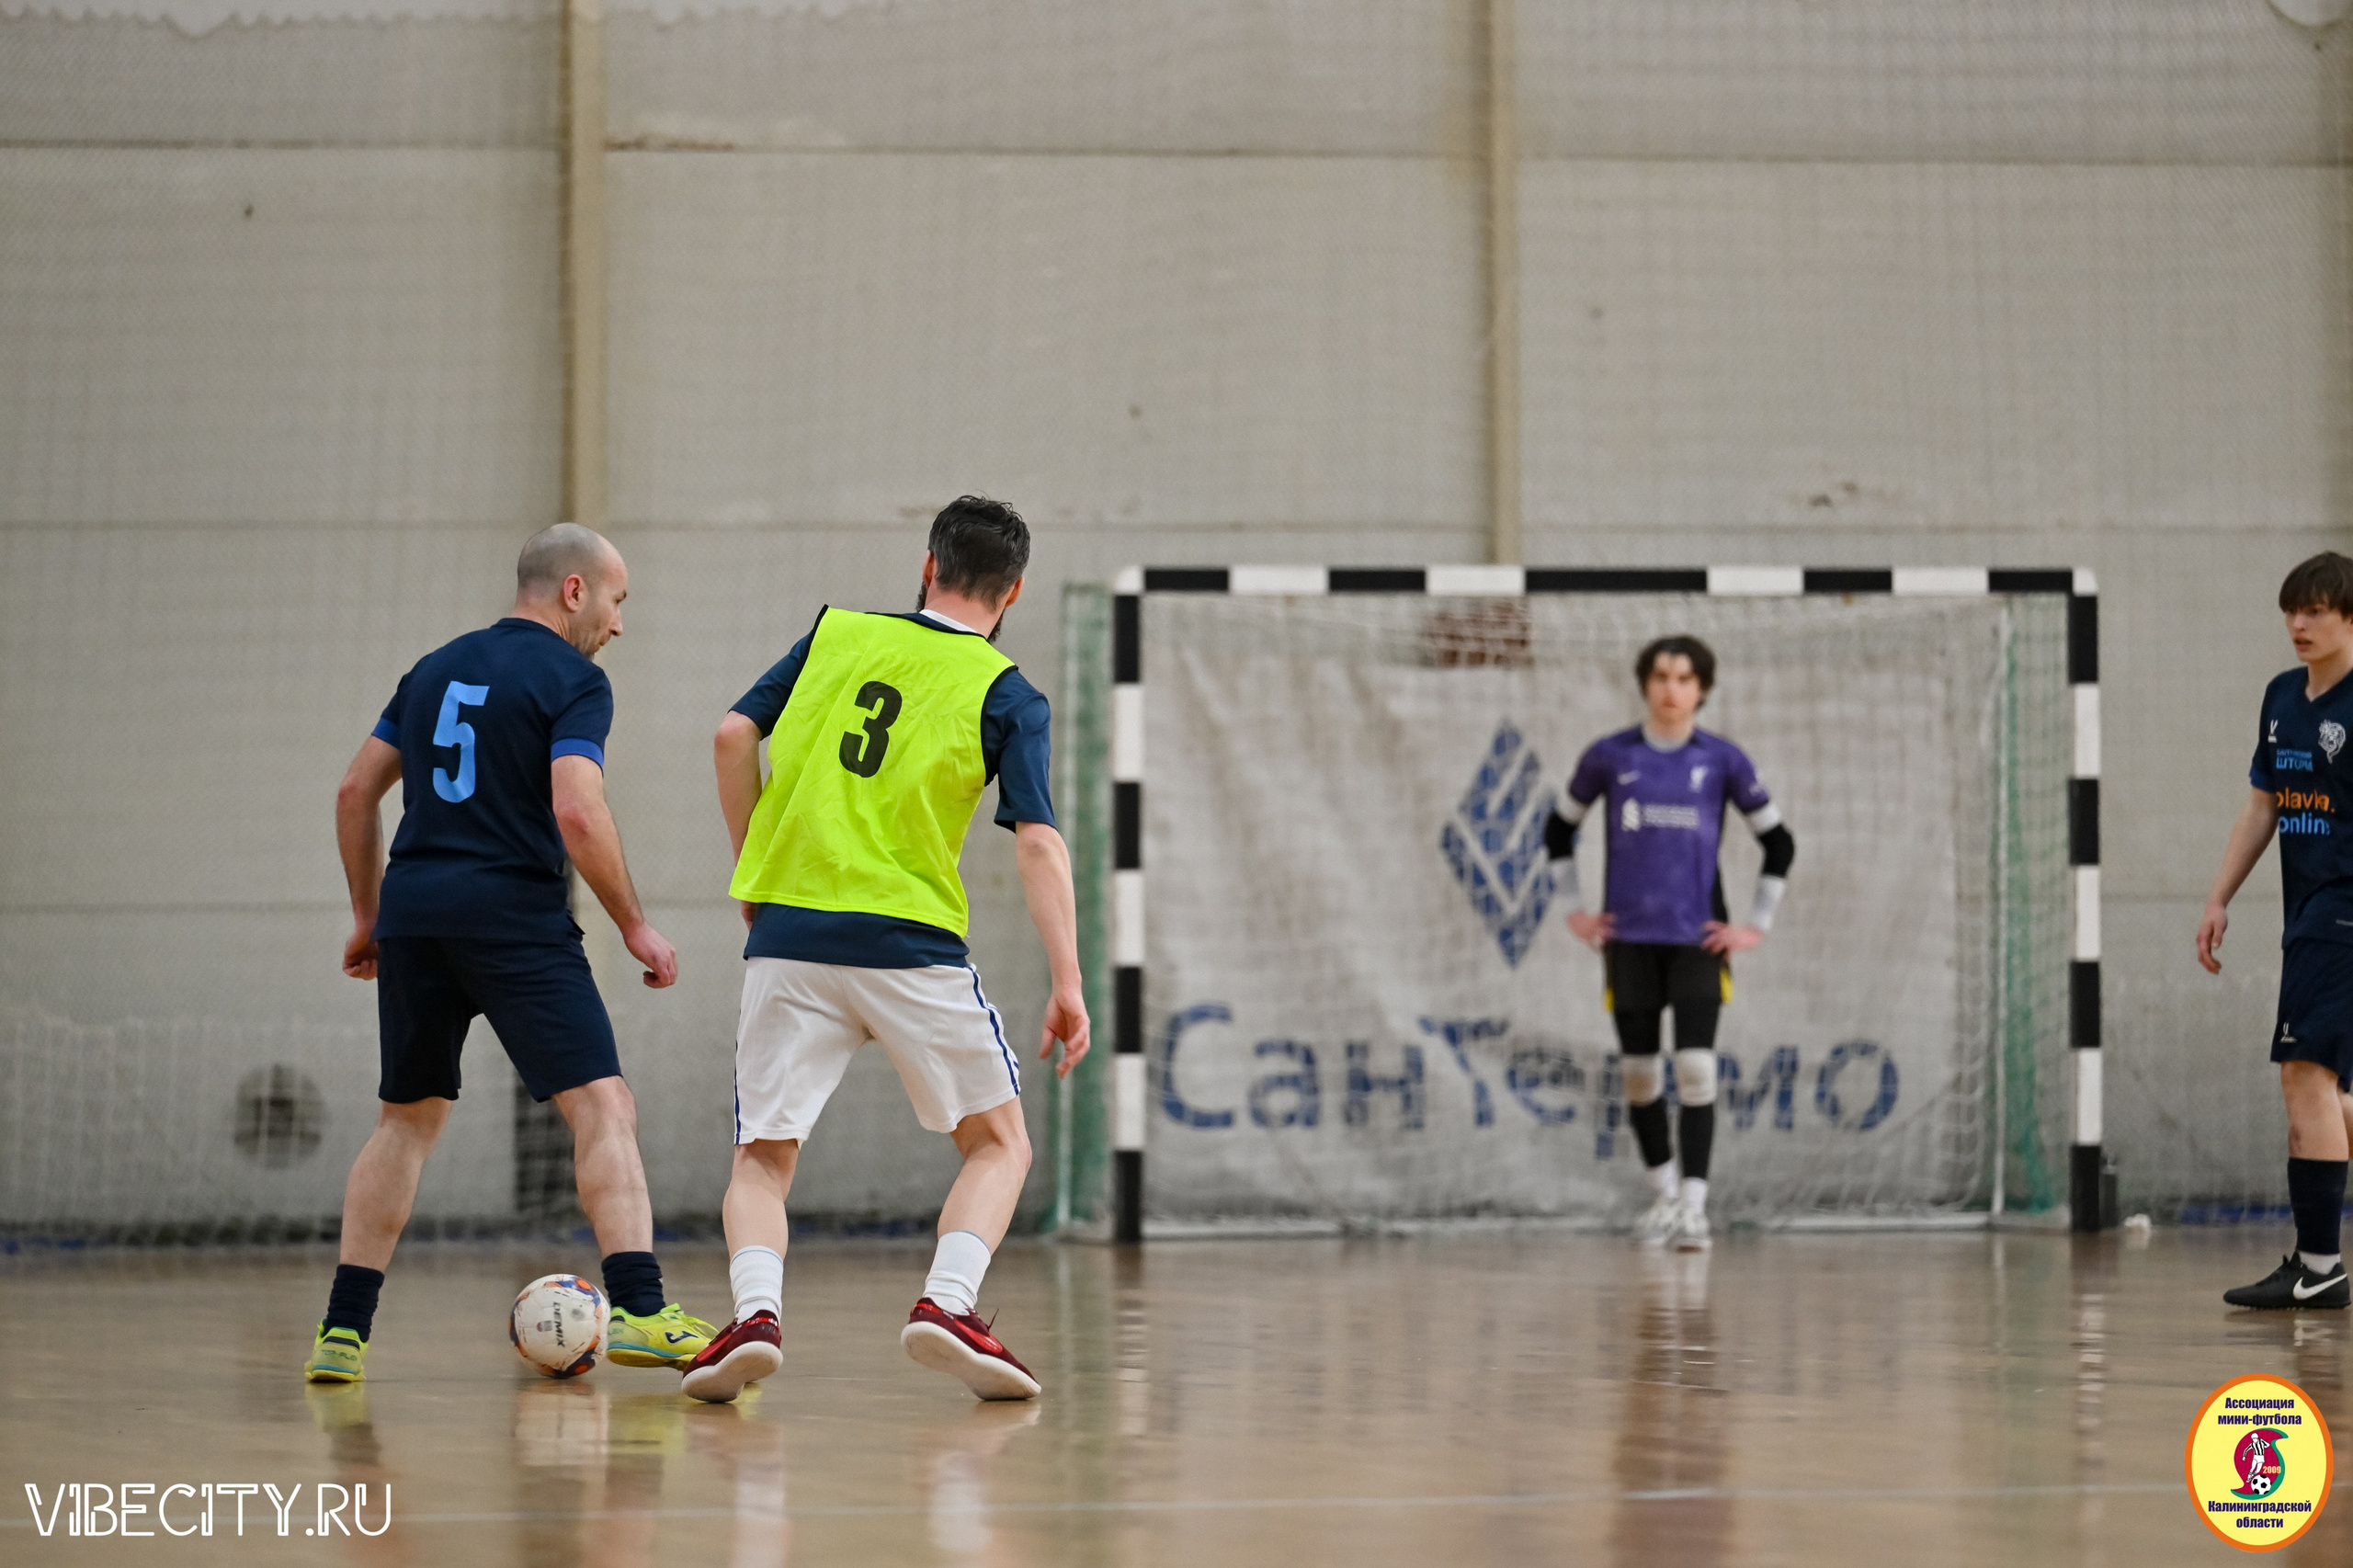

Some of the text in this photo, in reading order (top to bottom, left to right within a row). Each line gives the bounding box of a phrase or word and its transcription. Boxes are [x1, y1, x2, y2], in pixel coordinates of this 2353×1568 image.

[432, 680, 490, 803] 5
[838, 680, 903, 778] 3
[553, 1301, 565, 1347] DEMIX
